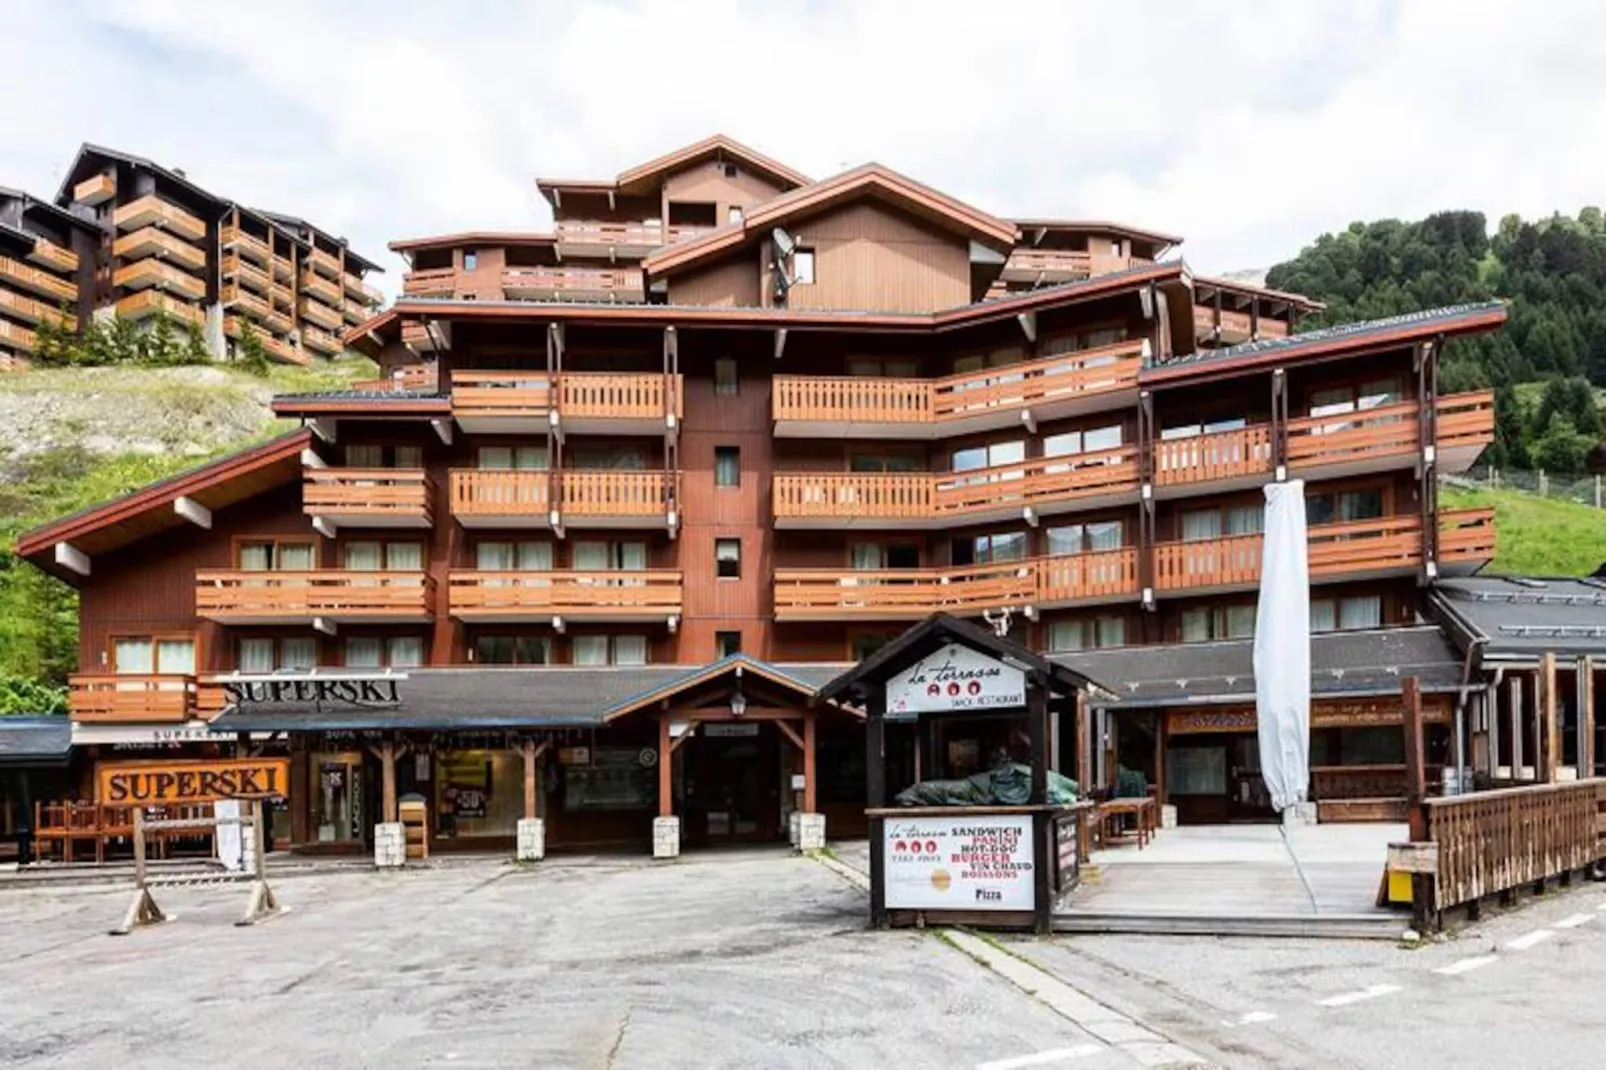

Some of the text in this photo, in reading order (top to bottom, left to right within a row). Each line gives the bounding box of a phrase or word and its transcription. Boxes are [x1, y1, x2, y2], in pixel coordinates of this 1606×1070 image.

[225, 680, 400, 709] SUPERSKI
[109, 767, 278, 800] SUPERSKI
[951, 827, 1022, 837] SANDWICH
[973, 836, 1018, 845] PANINI
[961, 845, 1017, 853] HOT-DOG
[951, 854, 1010, 863] BURGER
[969, 862, 1032, 871] VIN CHAUD
[961, 871, 1018, 879] BOISSONS
[975, 888, 1002, 901] Pizza
